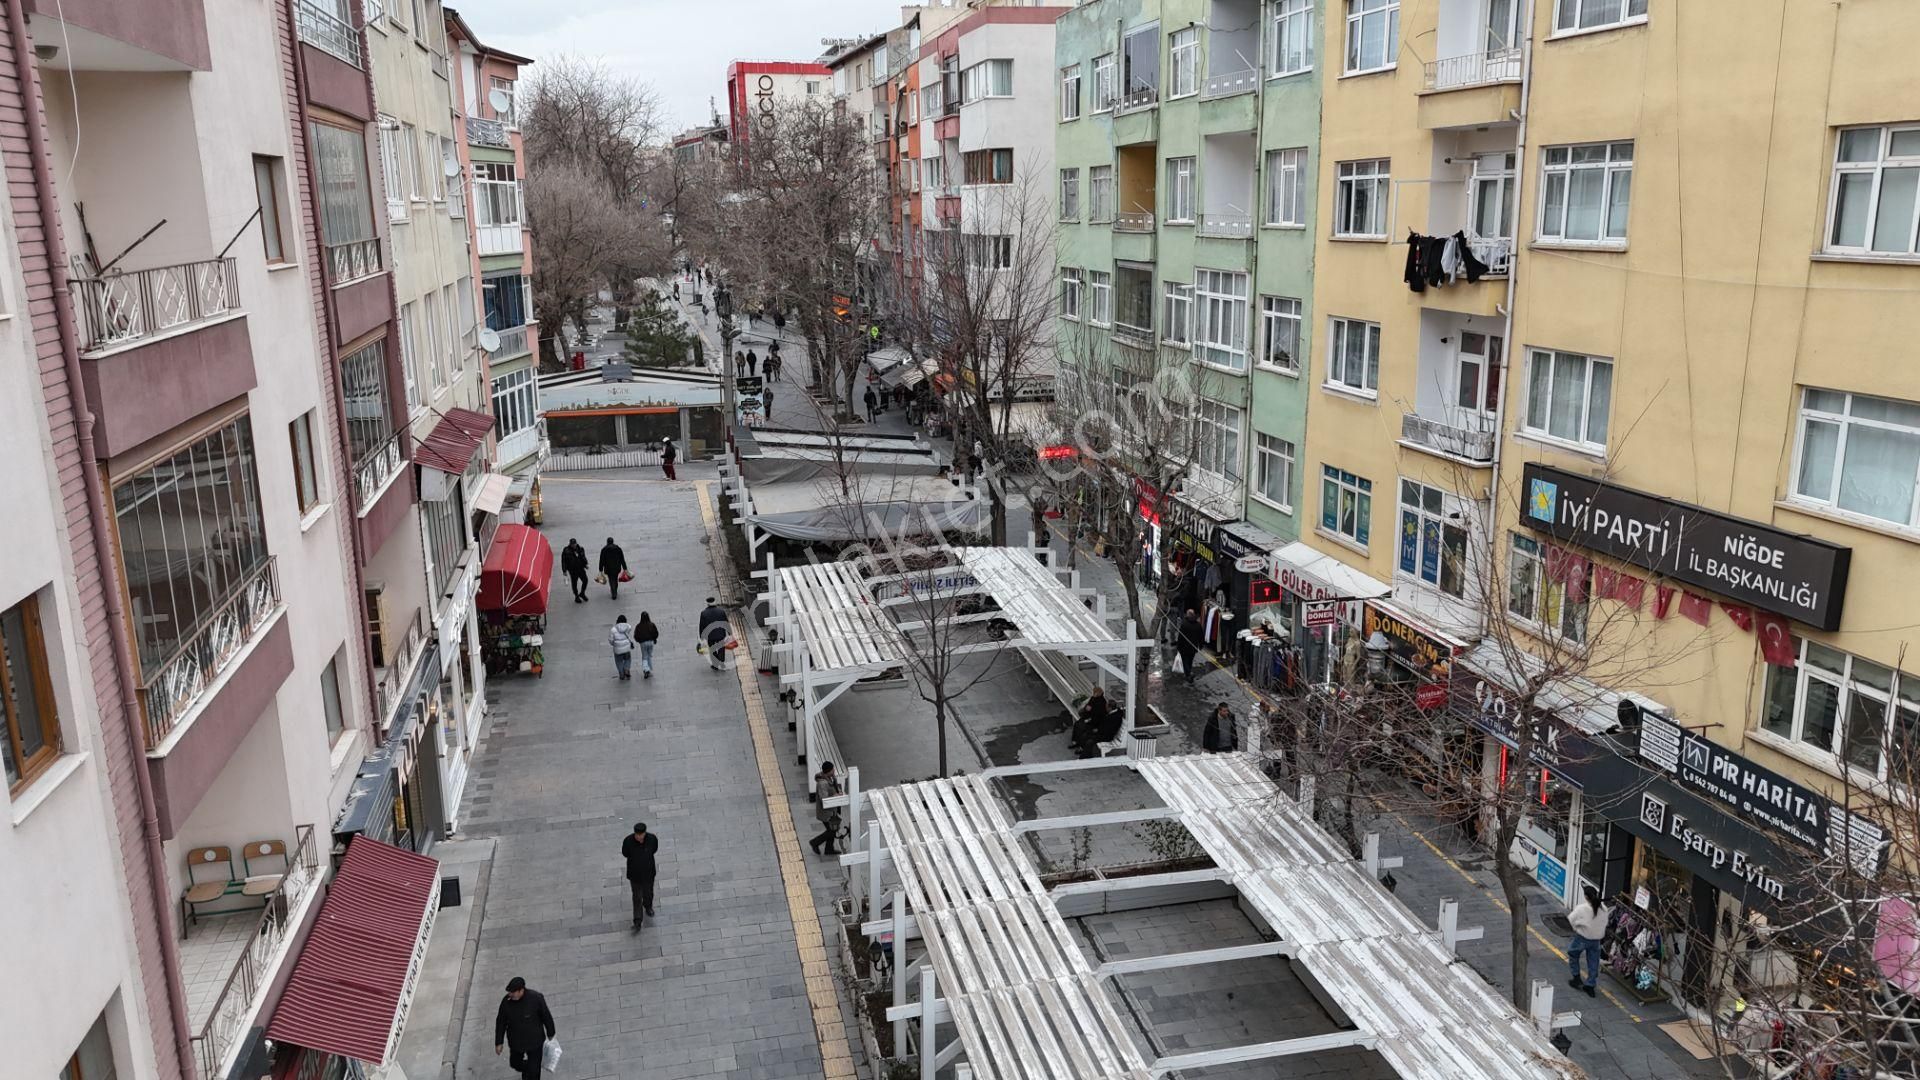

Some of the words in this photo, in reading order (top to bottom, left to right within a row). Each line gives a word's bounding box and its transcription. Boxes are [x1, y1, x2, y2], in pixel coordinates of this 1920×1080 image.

[1561, 490, 1591, 532] İYİ
[1593, 509, 1670, 557] PARTİ
[1723, 534, 1785, 570] NİĞDE
[910, 579, 943, 591] YILDZ
[1281, 568, 1313, 600] GÜLER
[1316, 586, 1347, 620] GİM
[1688, 548, 1703, 574] İL
[1706, 557, 1818, 611] BAŞKANLIĞI
[1508, 730, 1560, 766] AYLATMA
[1694, 775, 1706, 789] 542
[1712, 754, 1739, 785] PİR
[1742, 769, 1818, 828] HARİTA
[1670, 815, 1726, 870] Eşarp
[1731, 850, 1784, 901] Evim
[416, 943, 424, 960] VE
